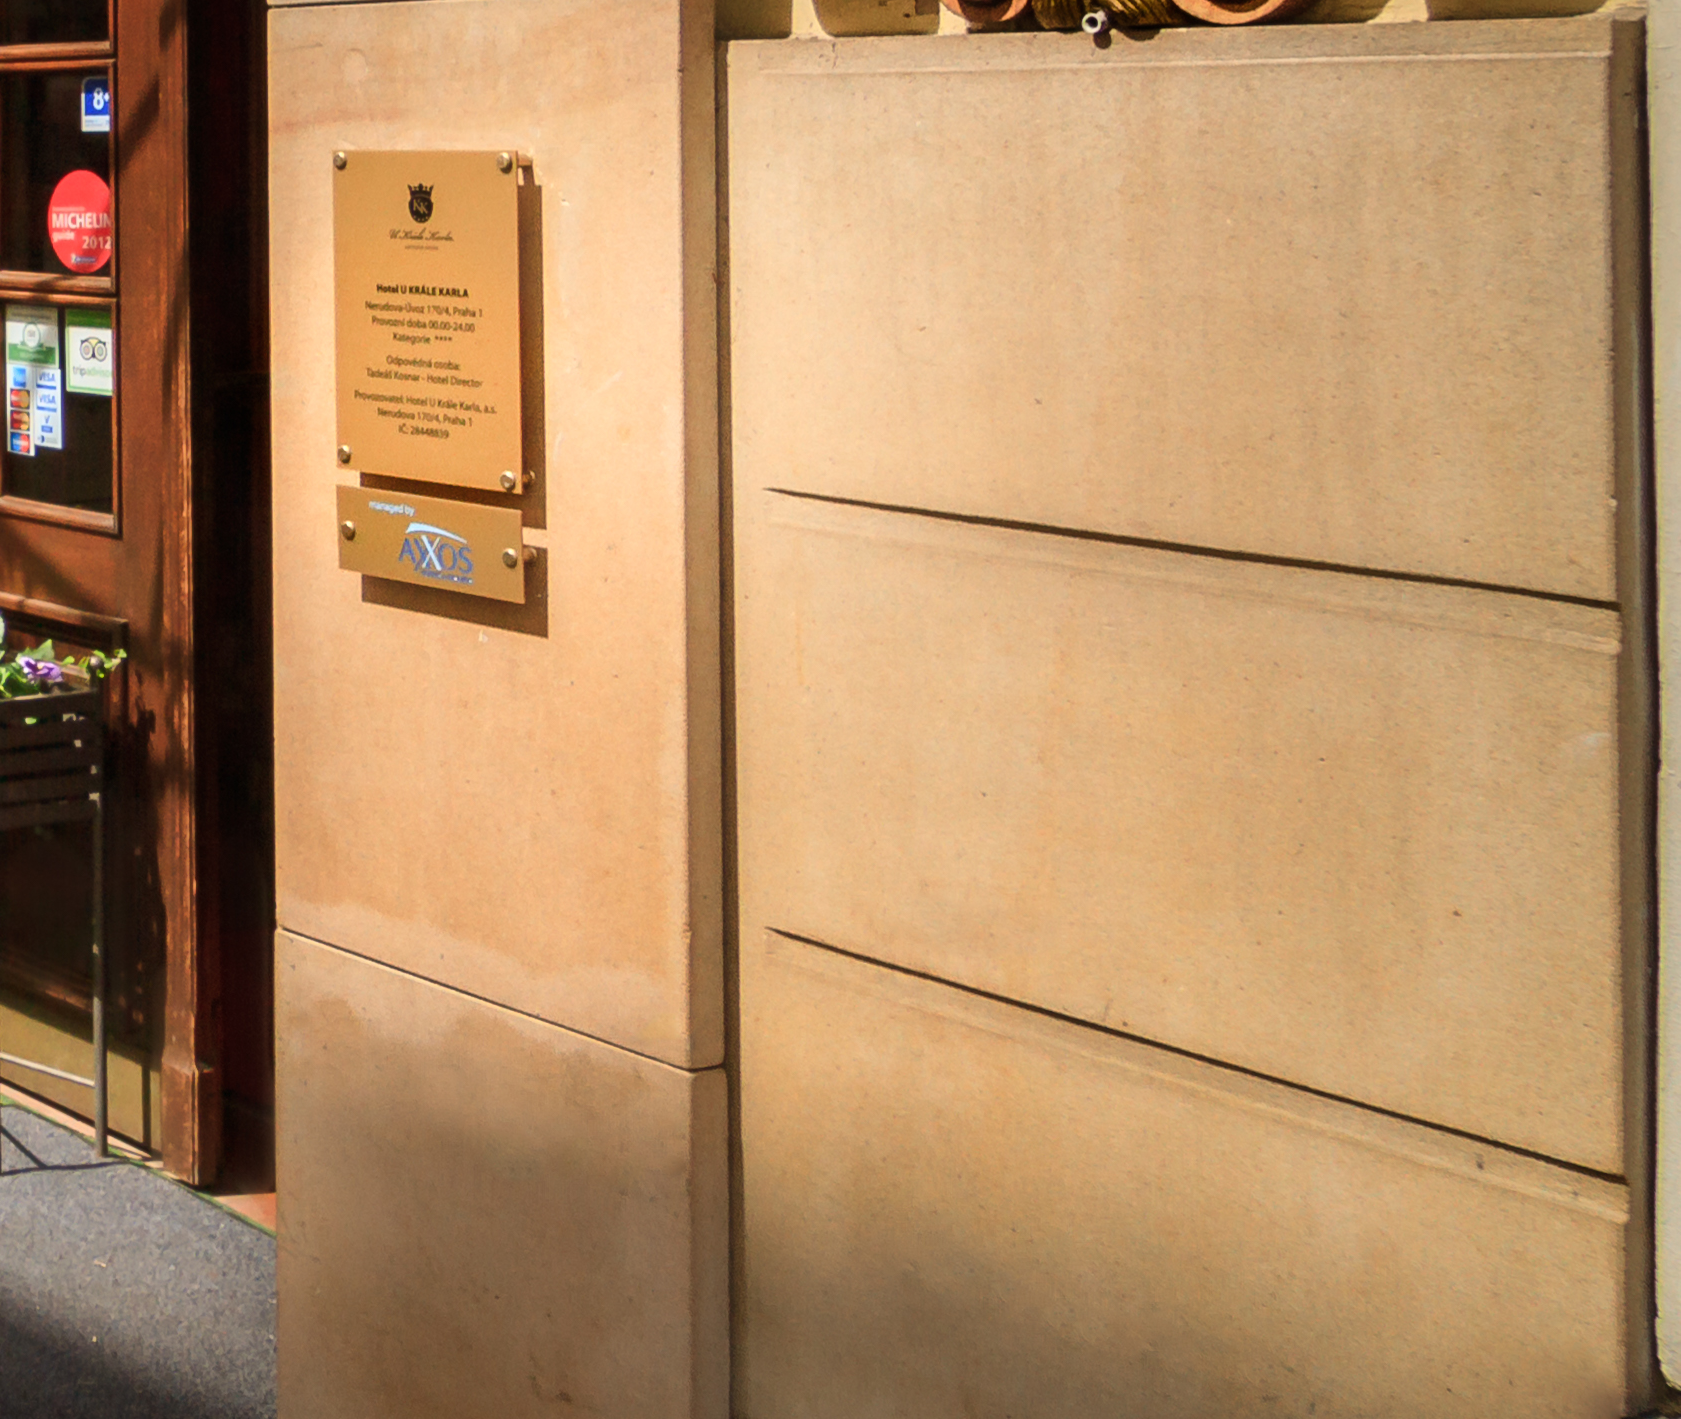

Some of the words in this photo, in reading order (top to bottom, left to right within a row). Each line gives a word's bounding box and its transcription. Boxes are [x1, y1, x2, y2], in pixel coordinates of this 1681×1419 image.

[52, 212, 112, 230] MICHELIN
[81, 235, 112, 250] 2012
[376, 283, 399, 295] Hotel
[400, 285, 408, 295] U
[408, 284, 437, 297] KRÁLE
[438, 287, 469, 299] KARLA
[453, 306, 476, 318] Praha
[406, 318, 427, 330] doba
[393, 332, 431, 346] Kategorie
[426, 375, 449, 386] Hotel
[450, 376, 483, 389] Director
[404, 504, 416, 517] by
